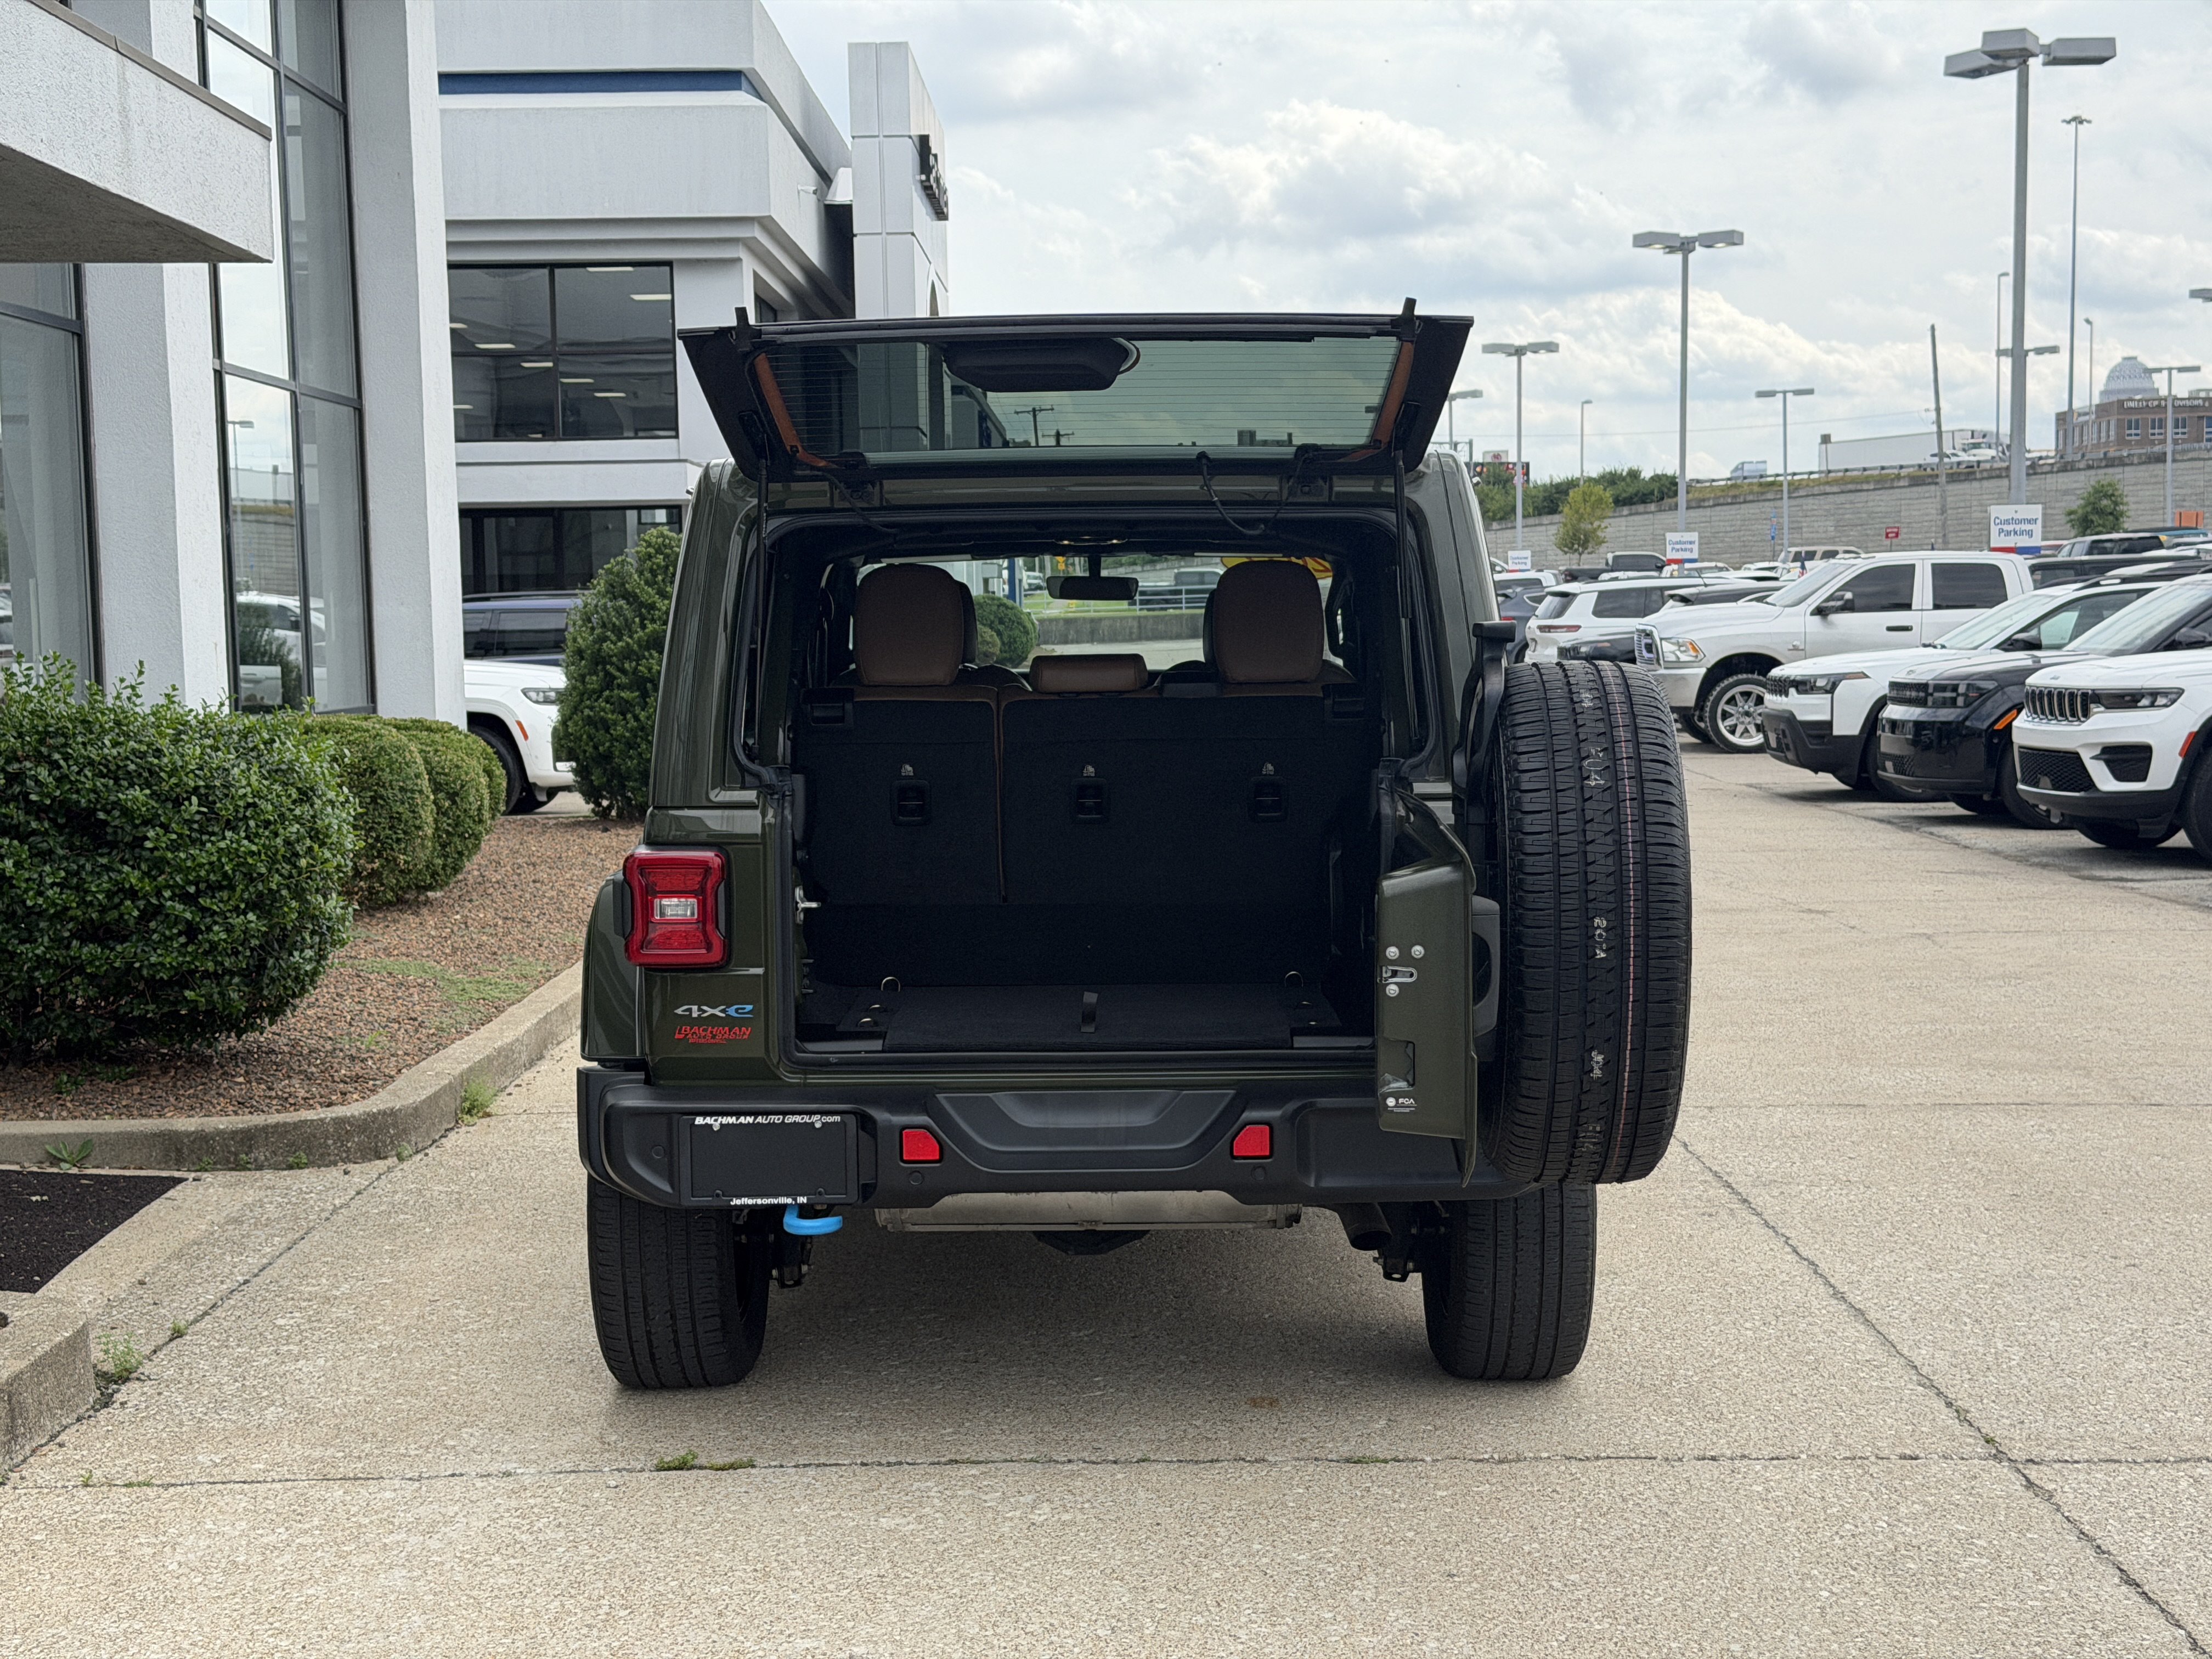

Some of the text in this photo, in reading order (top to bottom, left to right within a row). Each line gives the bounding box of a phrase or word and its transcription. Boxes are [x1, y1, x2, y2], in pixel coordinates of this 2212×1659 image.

[1994, 516, 2039, 526] Customer
[1998, 527, 2033, 539] Parking
[681, 1026, 751, 1035] BACHMAN
[695, 1116, 754, 1125] BACHMAN
[754, 1115, 783, 1124] AUTO
[730, 1197, 795, 1205] Jeffersonville,
